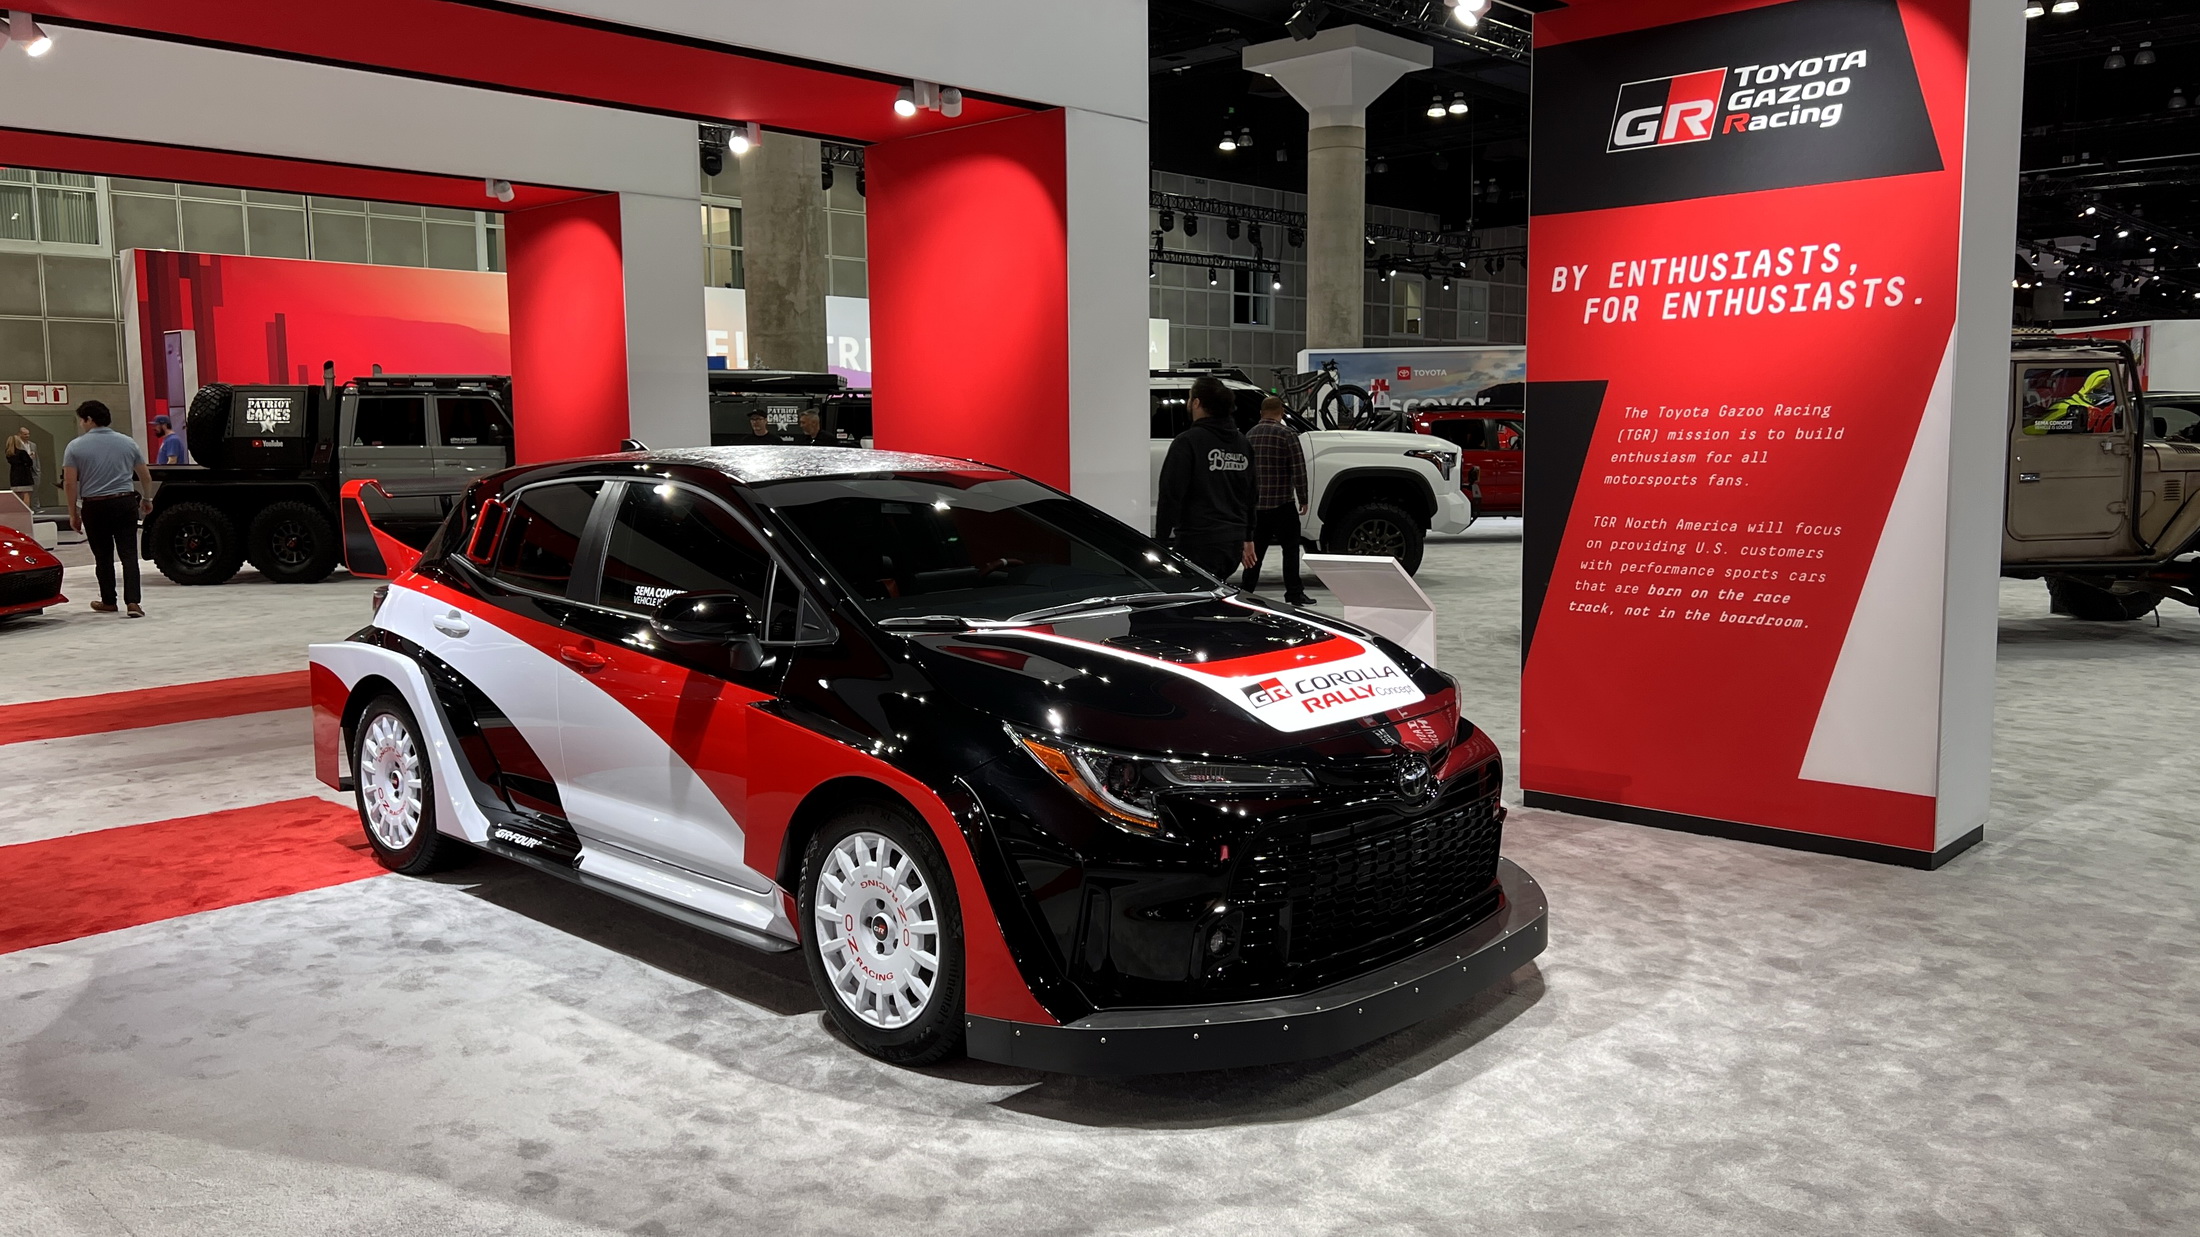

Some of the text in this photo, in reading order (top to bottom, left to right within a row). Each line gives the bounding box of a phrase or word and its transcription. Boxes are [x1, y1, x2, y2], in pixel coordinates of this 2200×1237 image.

[1733, 49, 1867, 88] TOYOTA
[1727, 76, 1851, 112] GAZOO
[1613, 98, 1715, 147] GR
[1721, 103, 1844, 134] Racing
[1551, 242, 1859, 293] BY ENTHUSIASTS,
[1583, 276, 1923, 325] FOR ENTHUSIASTS.
[1412, 369, 1448, 377] TOYOTA
[246, 408, 291, 421] GAMES
[247, 400, 291, 409] PATRIOT
[1625, 403, 1832, 421] The Toyota Gazoo Racing
[766, 413, 799, 423] GAMES
[1617, 426, 1845, 444] (TGR) mission is to build
[1610, 450, 1768, 464] enthusiasm for all
[1603, 473, 1751, 488] motorsports fans.
[1593, 515, 1842, 536] TGR North America will focus
[1586, 539, 1824, 559] on providing U.S. customers
[1580, 559, 1827, 583] with performance sports cars
[633, 595, 656, 607] VEHICLE
[634, 585, 655, 597] SEMA
[1575, 579, 1791, 604] that are born on the race
[1569, 601, 1809, 629] track, not in the boardroom.
[1294, 665, 1400, 695] COROLLA
[1248, 685, 1292, 705] GR
[1300, 683, 1376, 714] RALLY
[1375, 684, 1416, 697] Concept
[860, 879, 899, 903] RACING
[855, 956, 895, 981] RACING
